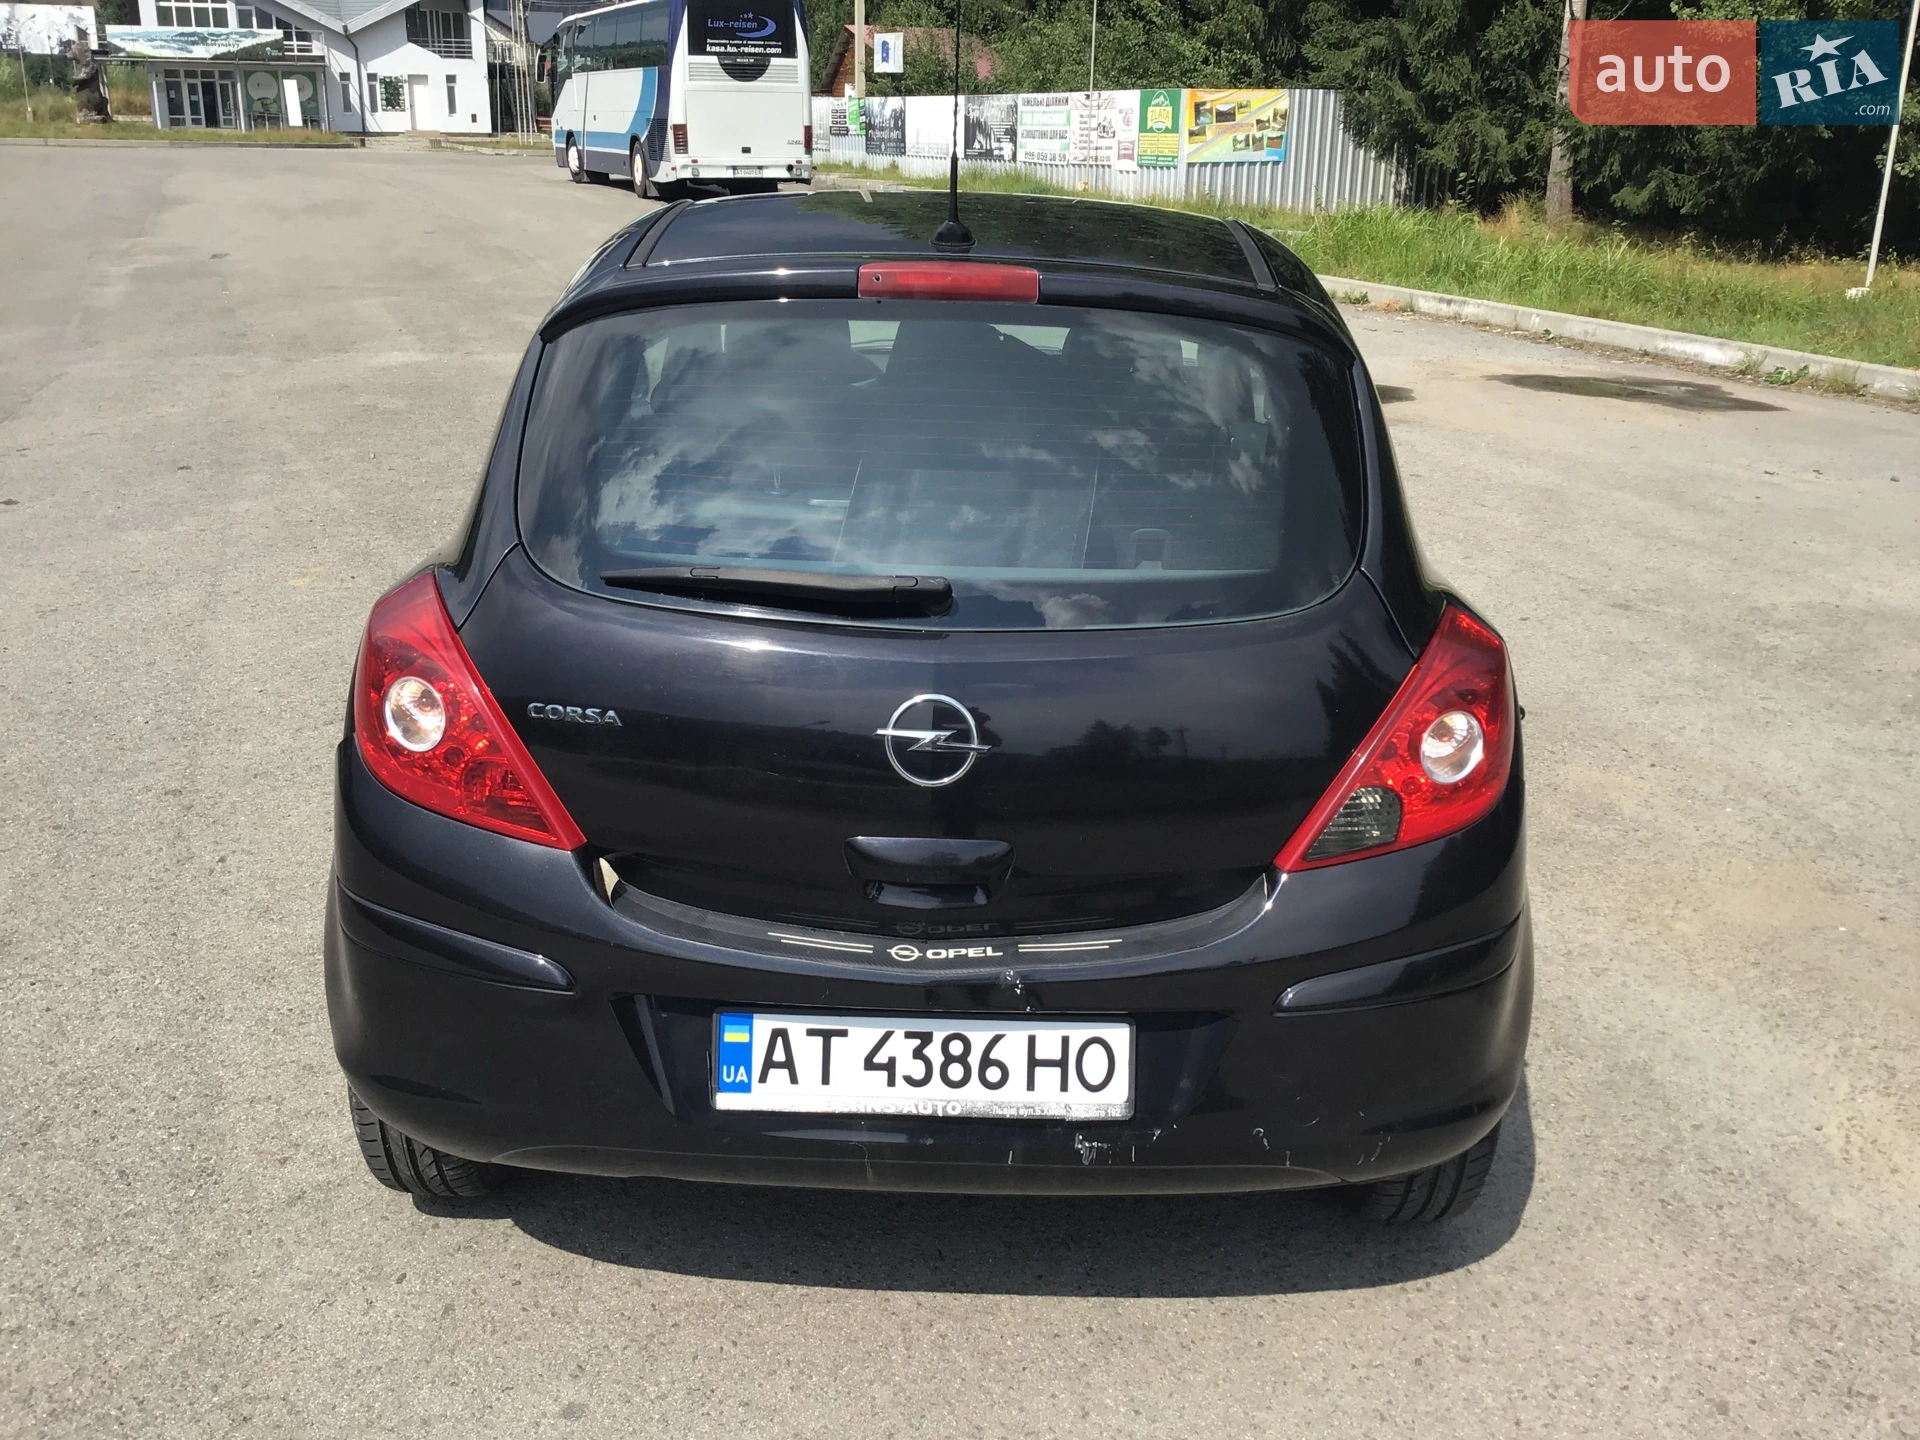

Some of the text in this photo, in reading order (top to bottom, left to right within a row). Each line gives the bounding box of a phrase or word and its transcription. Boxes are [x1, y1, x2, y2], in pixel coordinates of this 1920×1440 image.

[707, 19, 758, 29] Lux-reisen
[706, 44, 782, 54] kasa.lux-reisen.com
[1149, 108, 1170, 122] ZLATA
[527, 702, 622, 727] CORSA
[926, 946, 1004, 959] OPEL
[863, 1030, 1010, 1090] 4386
[722, 1065, 748, 1083] UA
[1107, 1108, 1122, 1117] 192
